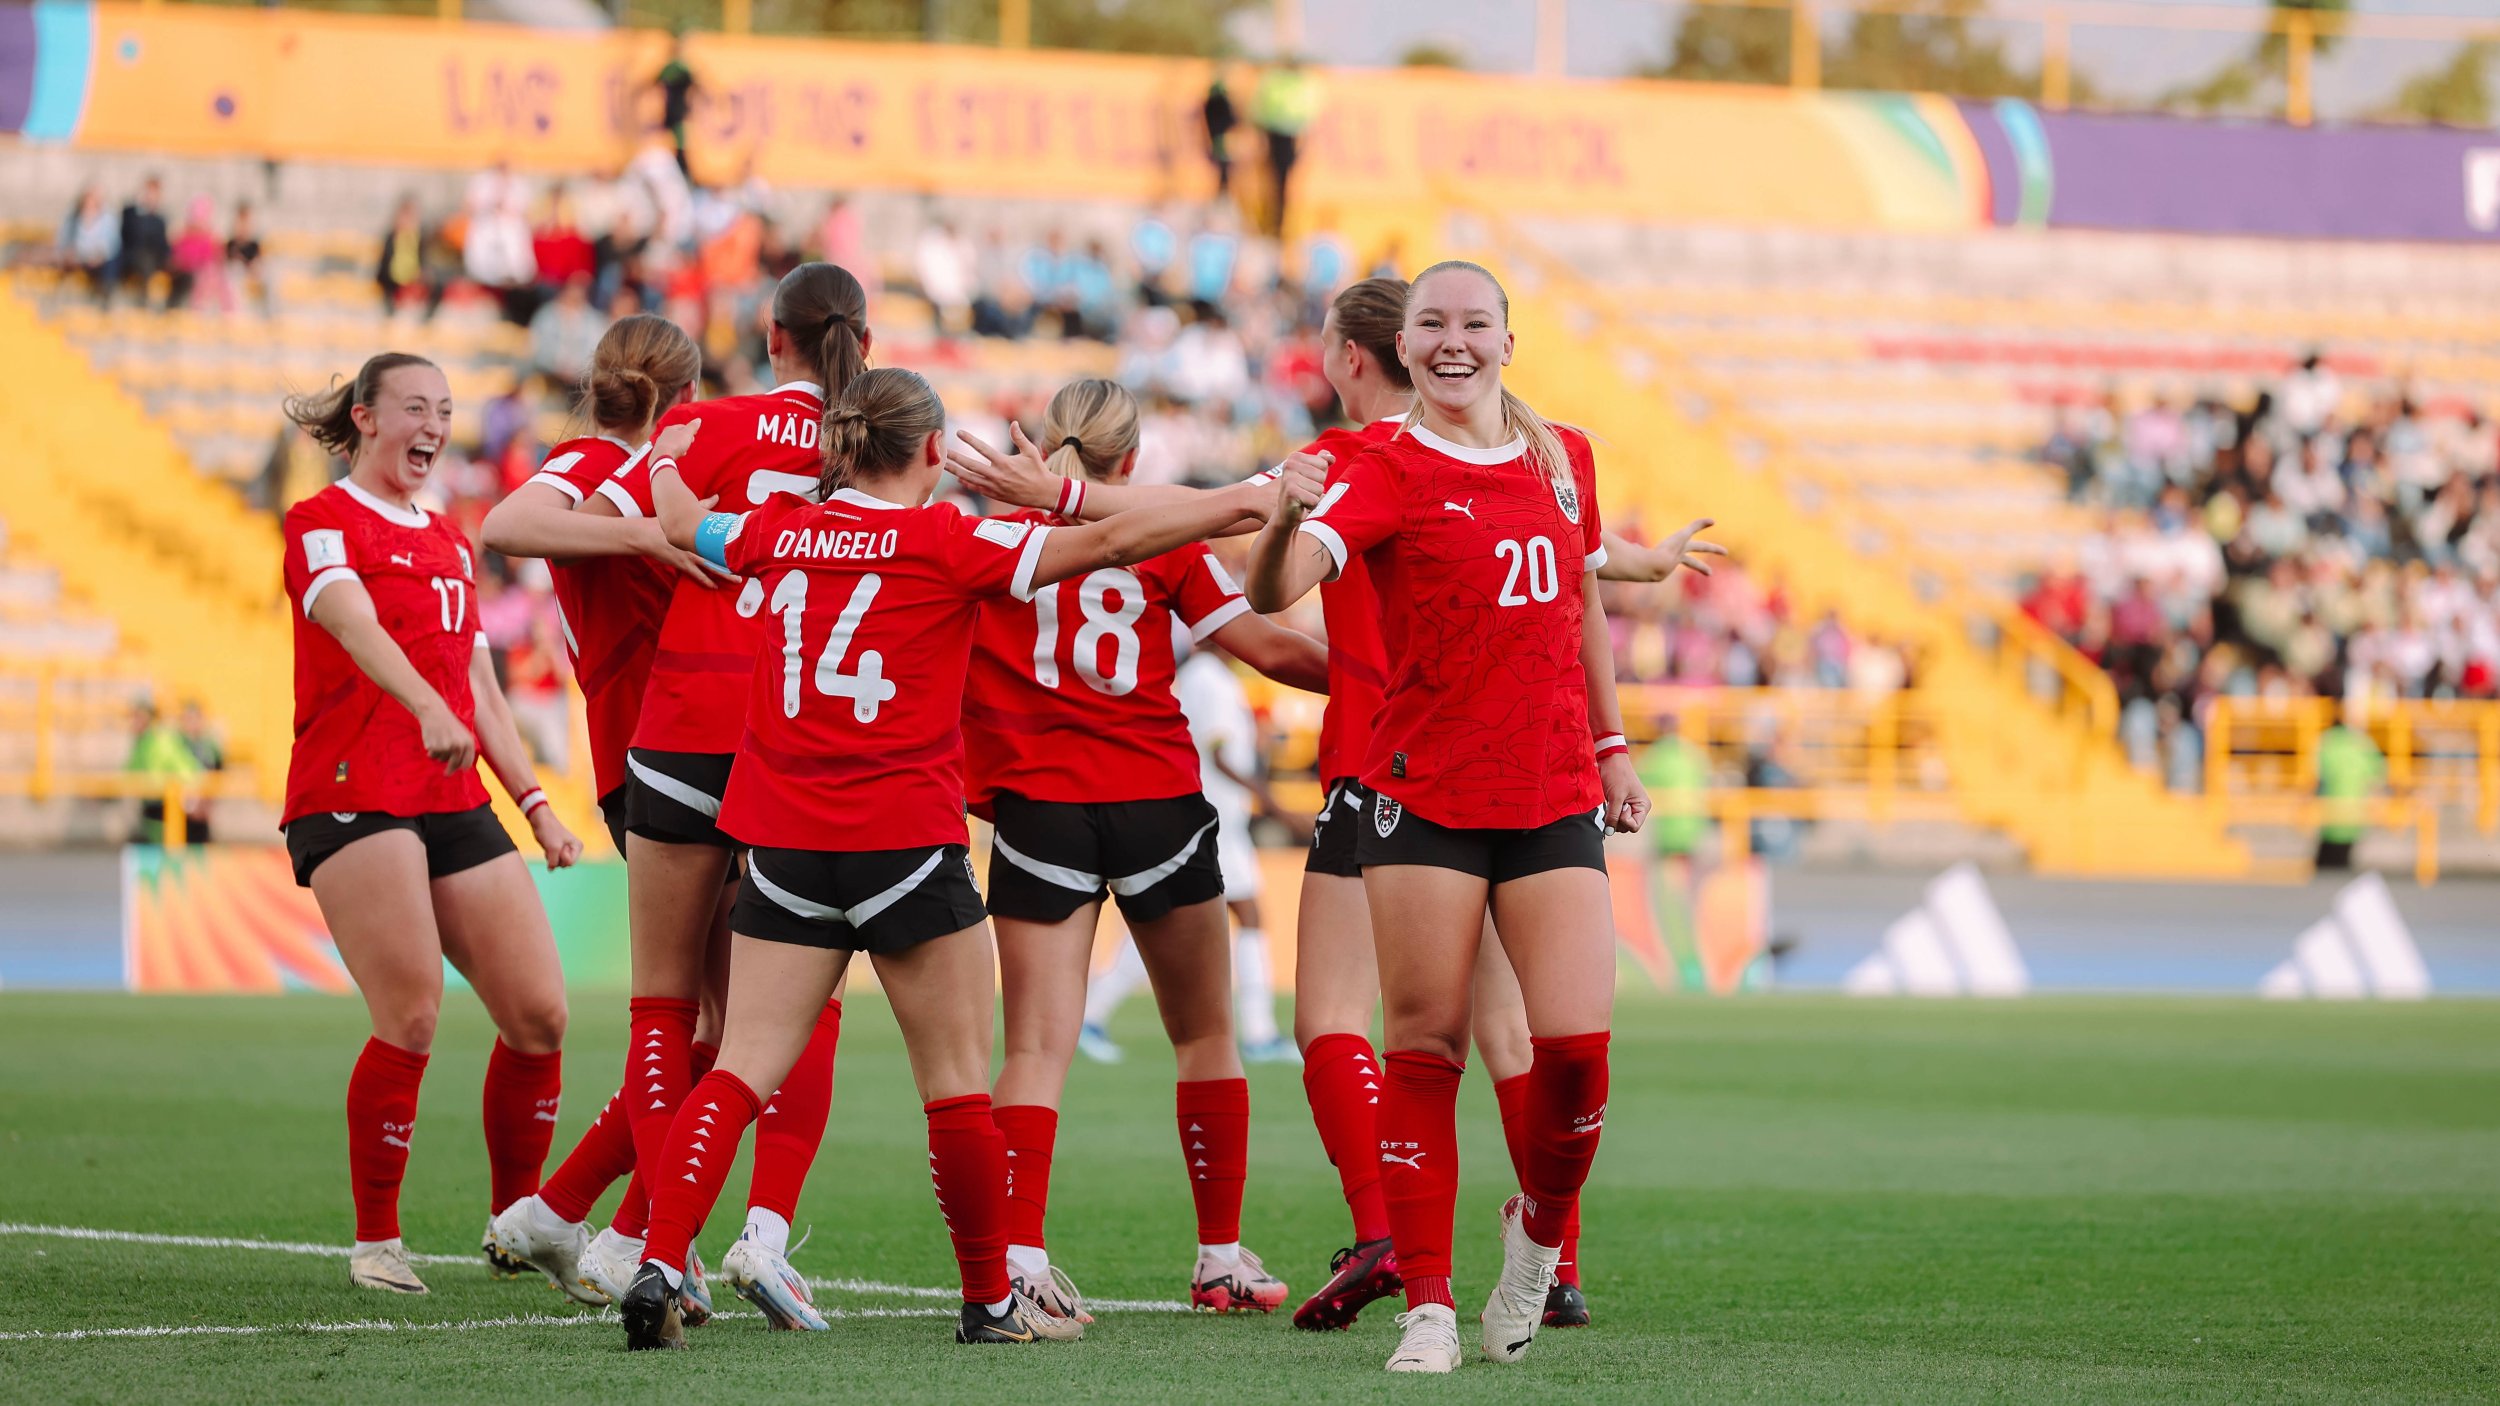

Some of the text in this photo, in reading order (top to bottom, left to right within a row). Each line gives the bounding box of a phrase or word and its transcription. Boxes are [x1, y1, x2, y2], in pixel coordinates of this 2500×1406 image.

[756, 412, 822, 449] MÄD
[1494, 535, 1559, 607] 20
[430, 575, 466, 634] 17
[1033, 567, 1148, 697] 18
[770, 568, 897, 724] 14
[1380, 1140, 1419, 1150] ÖFB
